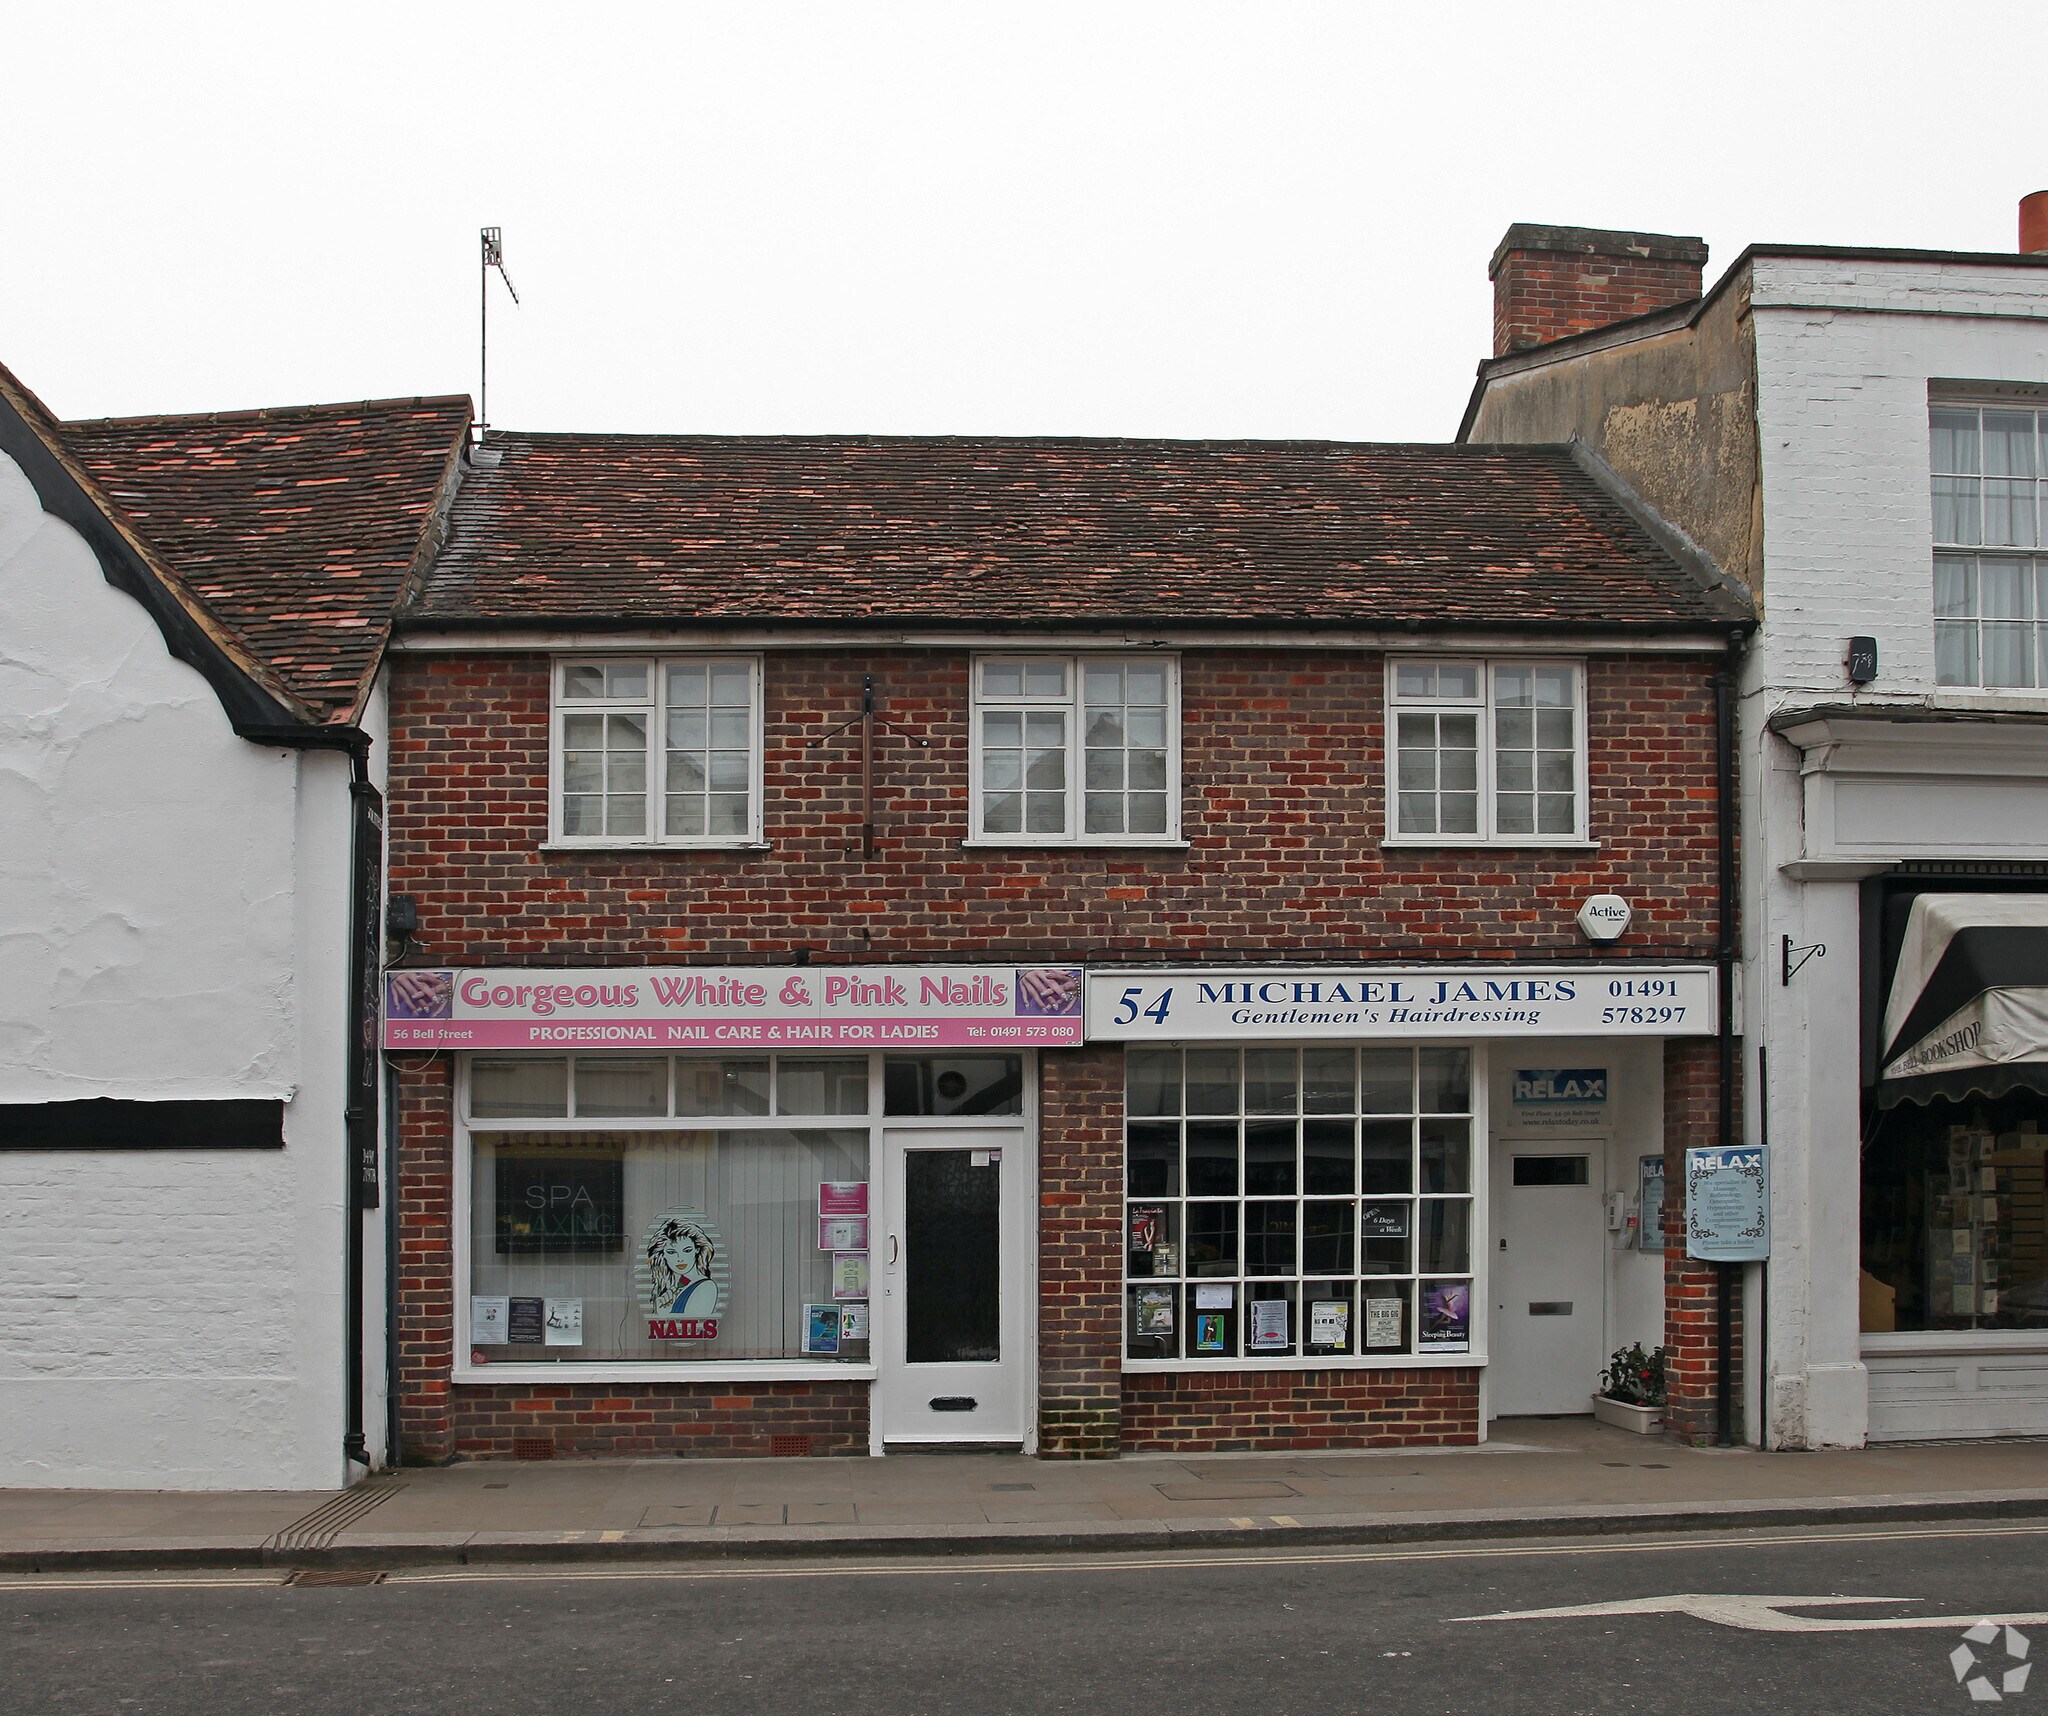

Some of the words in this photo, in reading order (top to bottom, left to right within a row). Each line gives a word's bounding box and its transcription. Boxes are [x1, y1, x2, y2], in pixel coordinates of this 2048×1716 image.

[1588, 904, 1627, 918] Active
[460, 976, 639, 1015] Gorgeous
[649, 975, 767, 1006] White
[778, 975, 812, 1006] &
[825, 974, 906, 1006] Pink
[918, 974, 1008, 1006] Nails
[1195, 982, 1415, 1004] MICHAEL
[1429, 980, 1577, 1005] JAMES
[1608, 979, 1679, 998] 01491
[1113, 987, 1174, 1025] 54
[1601, 1006, 1687, 1024] 578297
[1231, 1008, 1379, 1025] Gentlemen's
[1389, 1006, 1542, 1026] Hairdressing
[392, 1029, 409, 1040] 56
[412, 1028, 435, 1040] Bell
[437, 1028, 474, 1040] Street
[529, 1026, 657, 1041] PROFESSIONAL
[667, 1026, 709, 1040] NAIL
[714, 1026, 762, 1040] CARE
[766, 1025, 782, 1039] &
[786, 1025, 834, 1039] HAIR
[839, 1025, 875, 1039] FOR
[880, 1025, 939, 1040] LADIES
[966, 1026, 986, 1038] Tel:
[989, 1026, 1022, 1038] 01491
[1025, 1026, 1048, 1038] 573
[1051, 1026, 1075, 1038] 080
[1902, 1055, 1920, 1071] BELL
[1515, 1079, 1604, 1099] RELAX
[1521, 1117, 1600, 1127] www.relaxtoday.co.uk
[1643, 1163, 1665, 1178] RELA
[1692, 1153, 1761, 1171] RELAX
[524, 1185, 595, 1209] SPA
[509, 1213, 614, 1238] WAXING
[647, 1318, 718, 1340] NAILS
